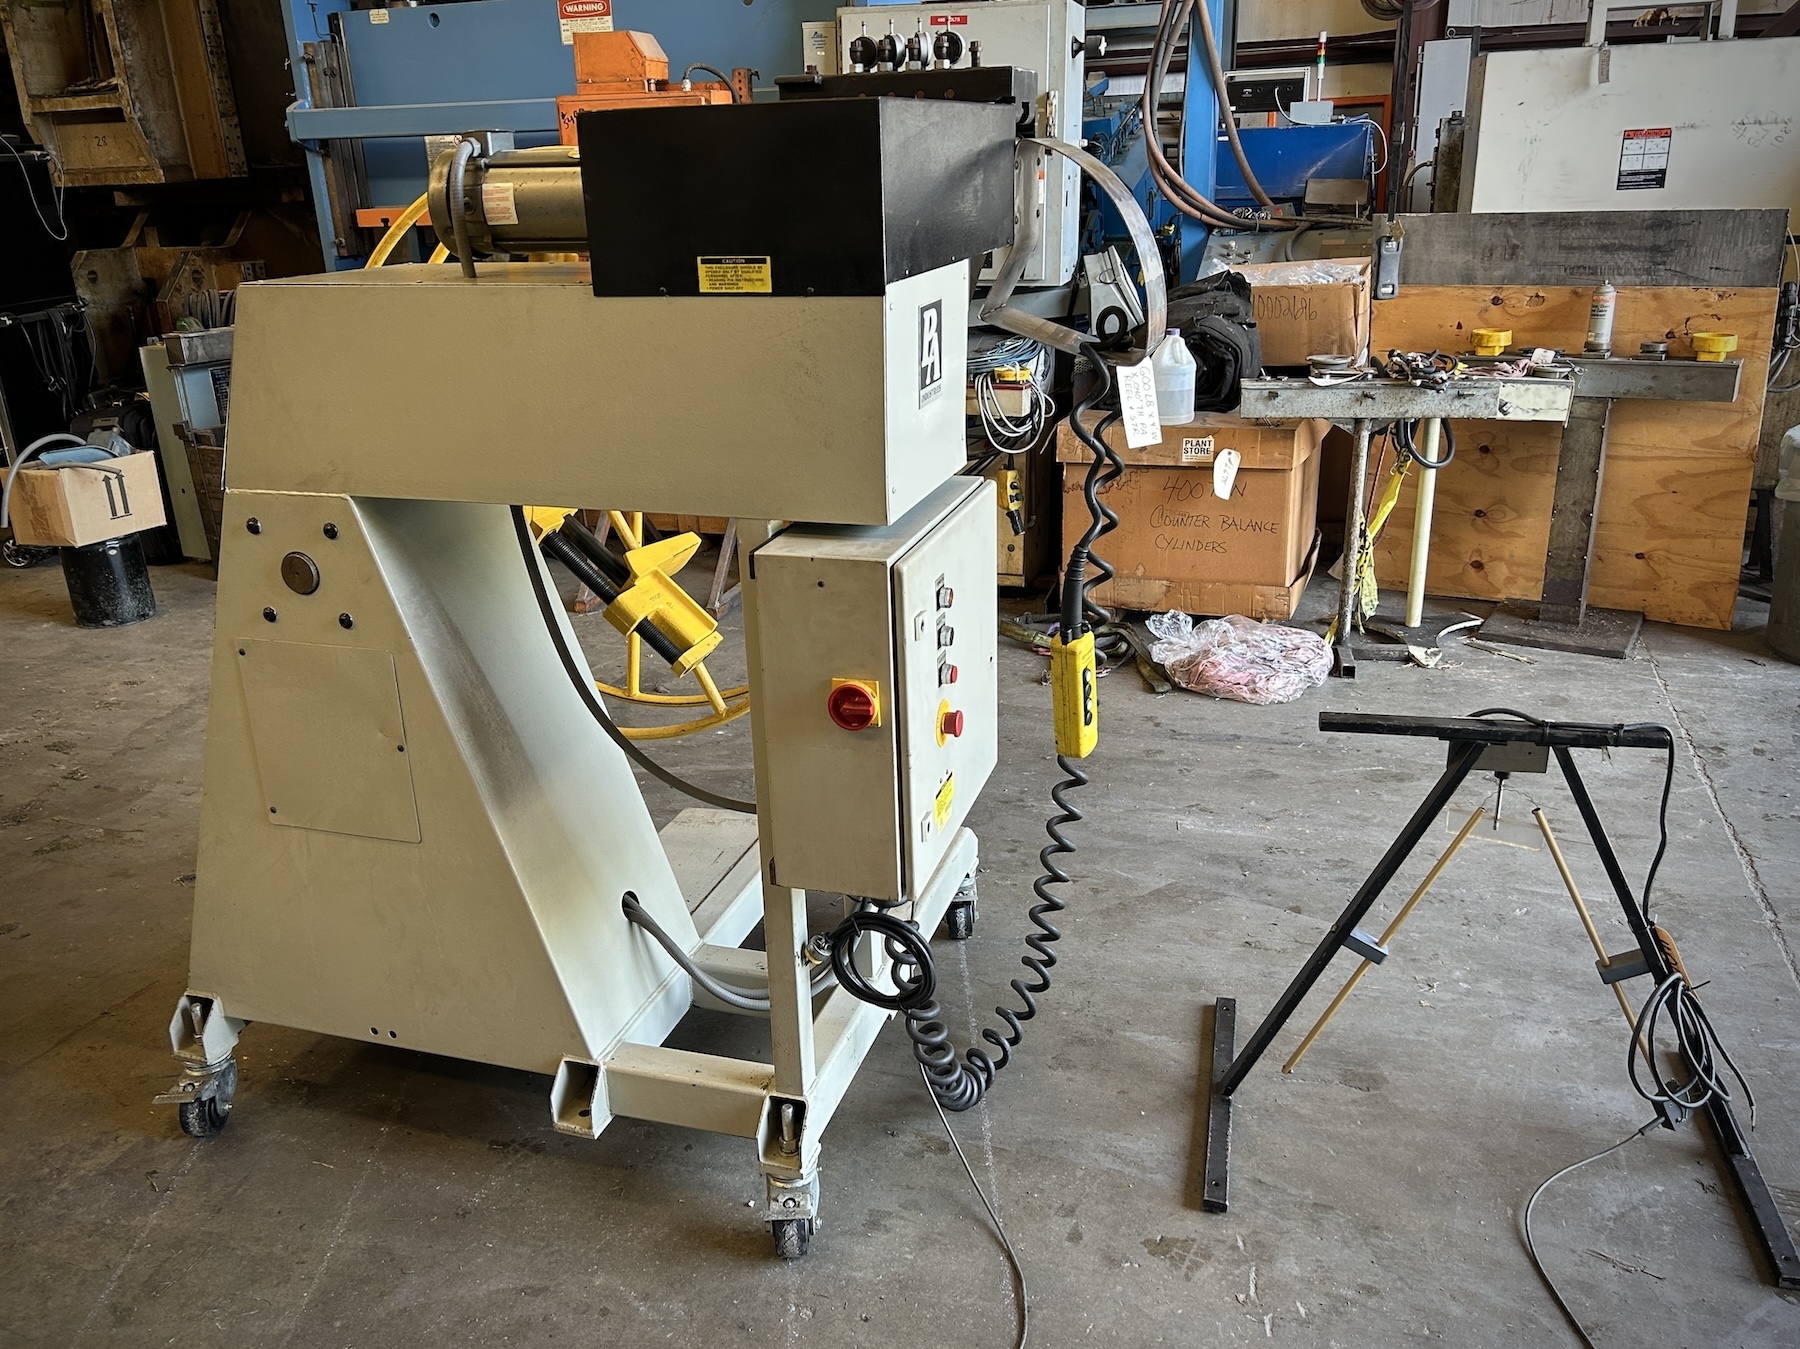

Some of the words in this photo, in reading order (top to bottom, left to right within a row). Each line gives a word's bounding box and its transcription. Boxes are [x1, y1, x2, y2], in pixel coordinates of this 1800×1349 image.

[565, 3, 604, 12] WARNING
[94, 135, 108, 147] 28
[1124, 375, 1133, 401] REEL
[1183, 447, 1211, 455] STORE
[1185, 439, 1212, 447] PLANT
[1163, 475, 1204, 504] 400
[1150, 504, 1211, 529] COUNTER
[1219, 514, 1281, 535] BALANCE
[1155, 533, 1228, 554] CYLINDERS
